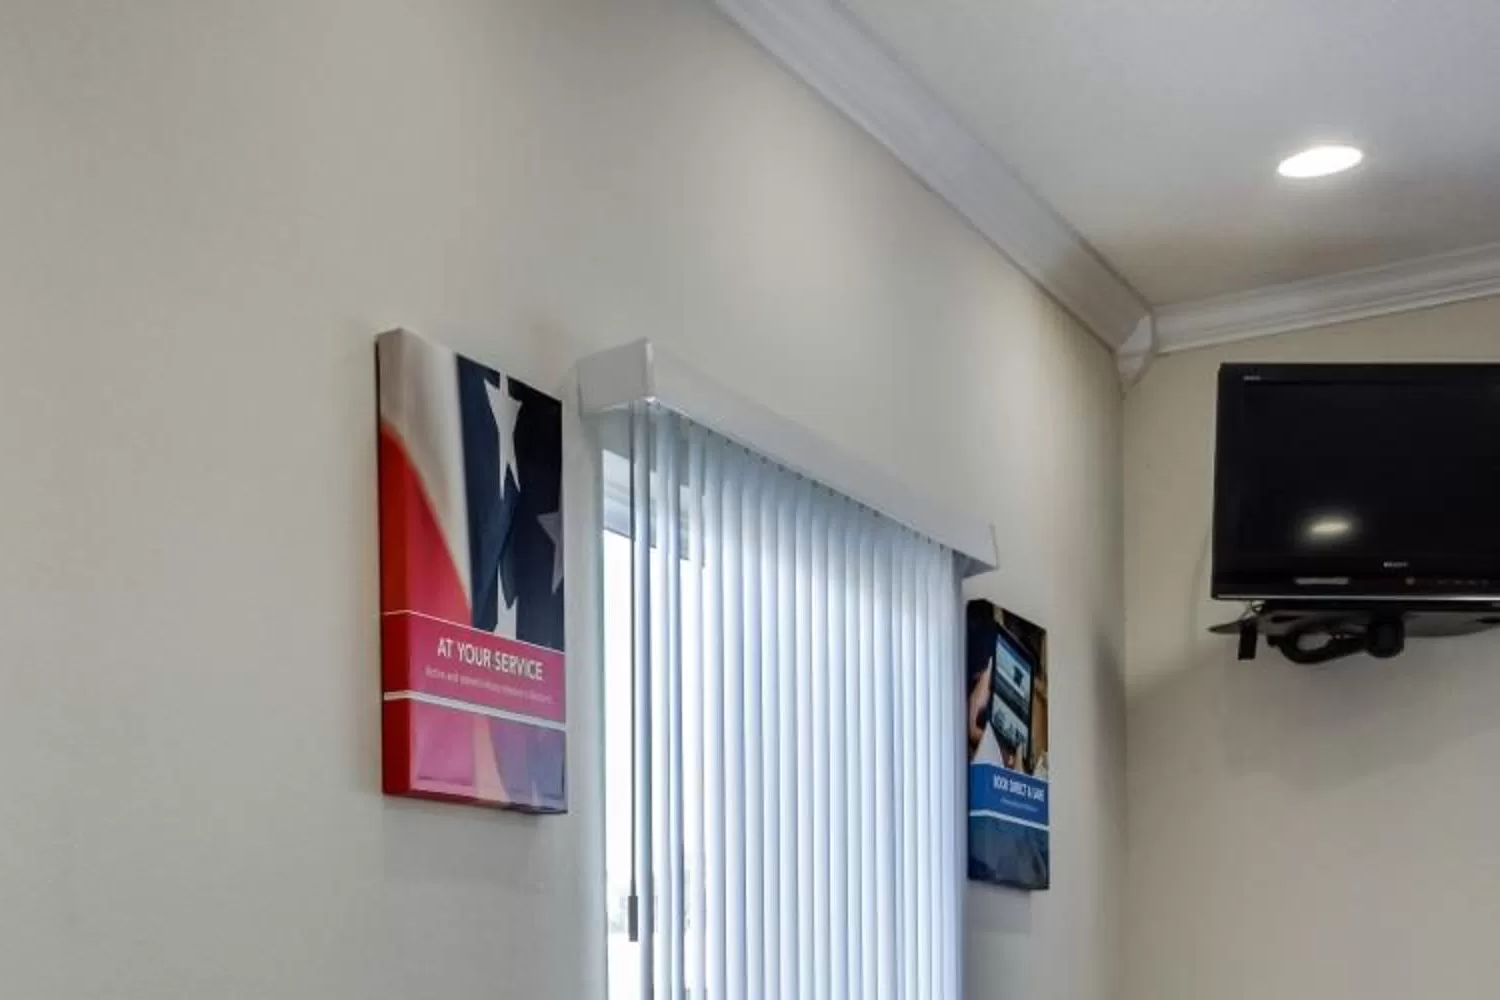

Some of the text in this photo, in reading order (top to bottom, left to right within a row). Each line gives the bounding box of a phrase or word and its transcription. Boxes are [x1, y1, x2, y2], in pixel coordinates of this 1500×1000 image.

[437, 637, 544, 681] AT YOUR SERVICE
